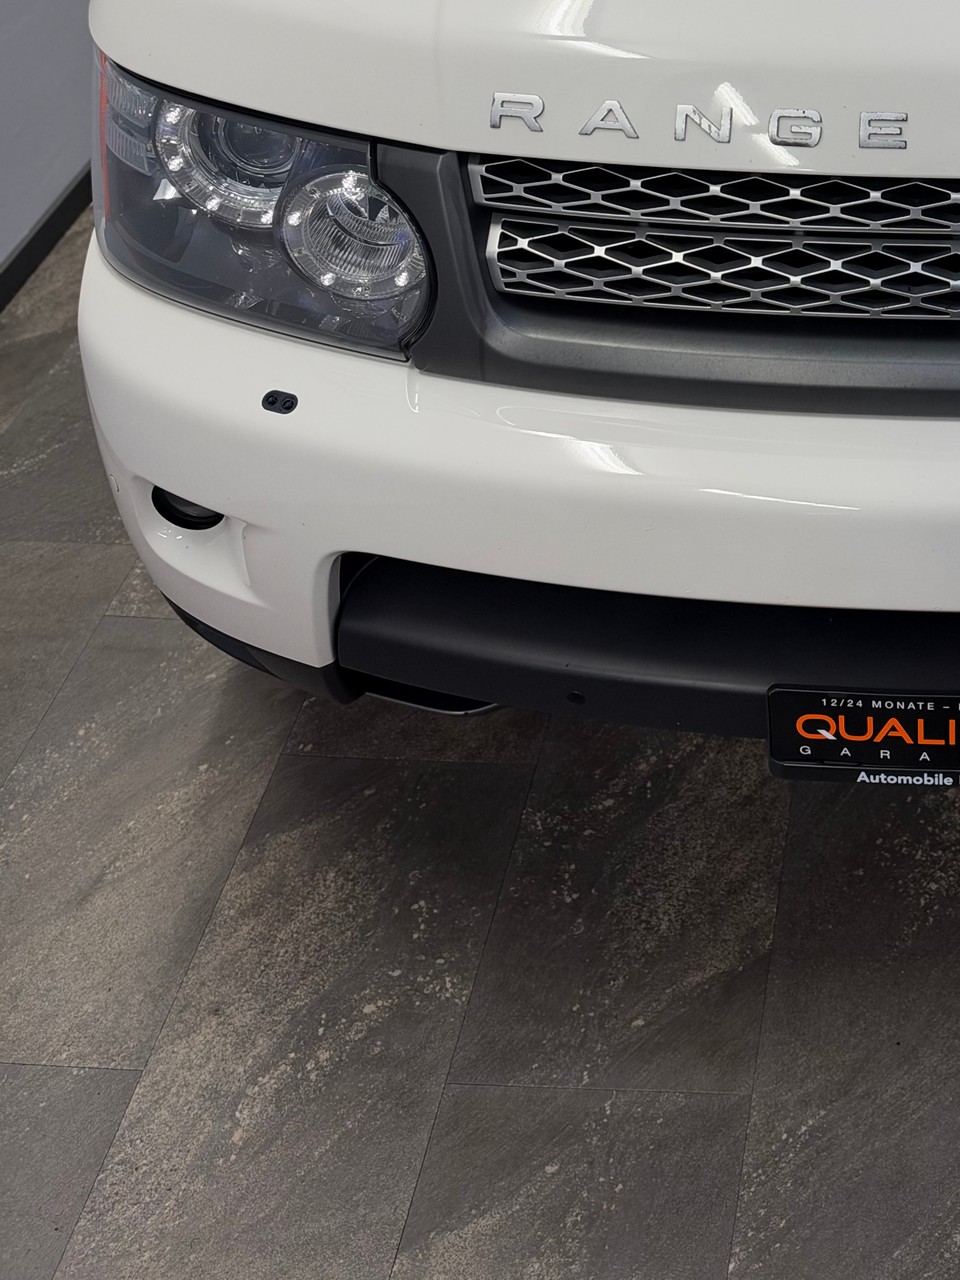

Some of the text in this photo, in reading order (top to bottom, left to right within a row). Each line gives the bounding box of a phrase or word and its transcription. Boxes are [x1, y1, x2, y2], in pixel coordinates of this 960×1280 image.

[489, 92, 908, 152] RANGE
[821, 698, 863, 708] 12/24
[871, 700, 935, 711] MONATE
[856, 771, 953, 786] Automobile
